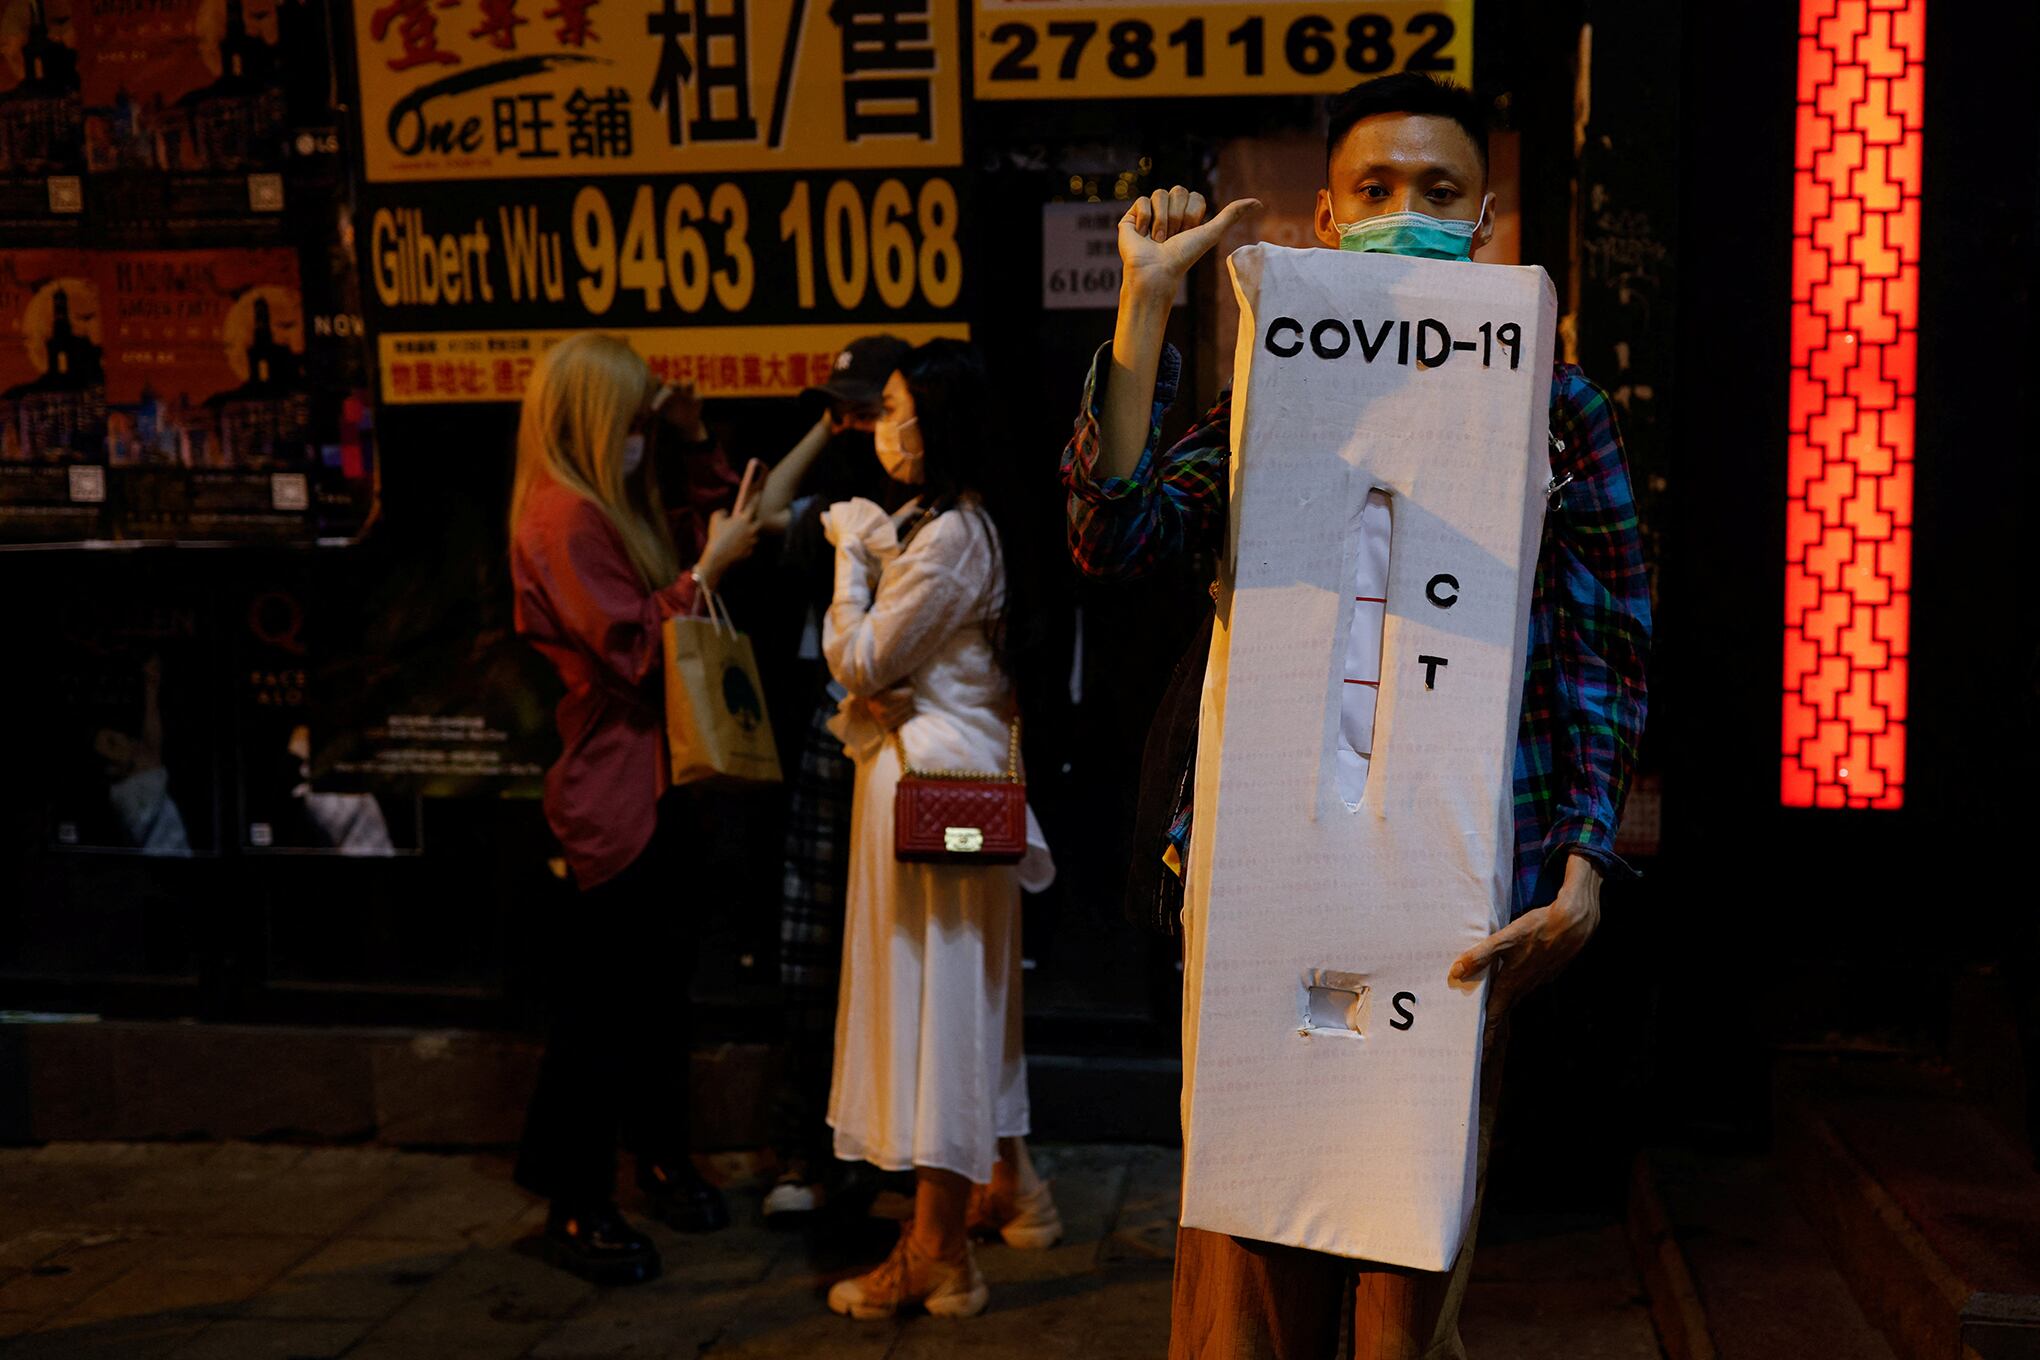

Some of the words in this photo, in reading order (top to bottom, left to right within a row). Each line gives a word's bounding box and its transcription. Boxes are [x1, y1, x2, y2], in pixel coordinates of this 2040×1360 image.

[988, 14, 1455, 81] 27811682
[493, 86, 633, 158] 旺舖
[369, 205, 495, 308] Gilbert
[499, 203, 566, 303] Wu
[570, 183, 757, 315] 9463
[778, 176, 965, 311] 1068
[1264, 316, 1521, 369] COVID-19
[1426, 573, 1459, 608] C
[1418, 654, 1448, 690] T
[1389, 991, 1416, 1031] S
